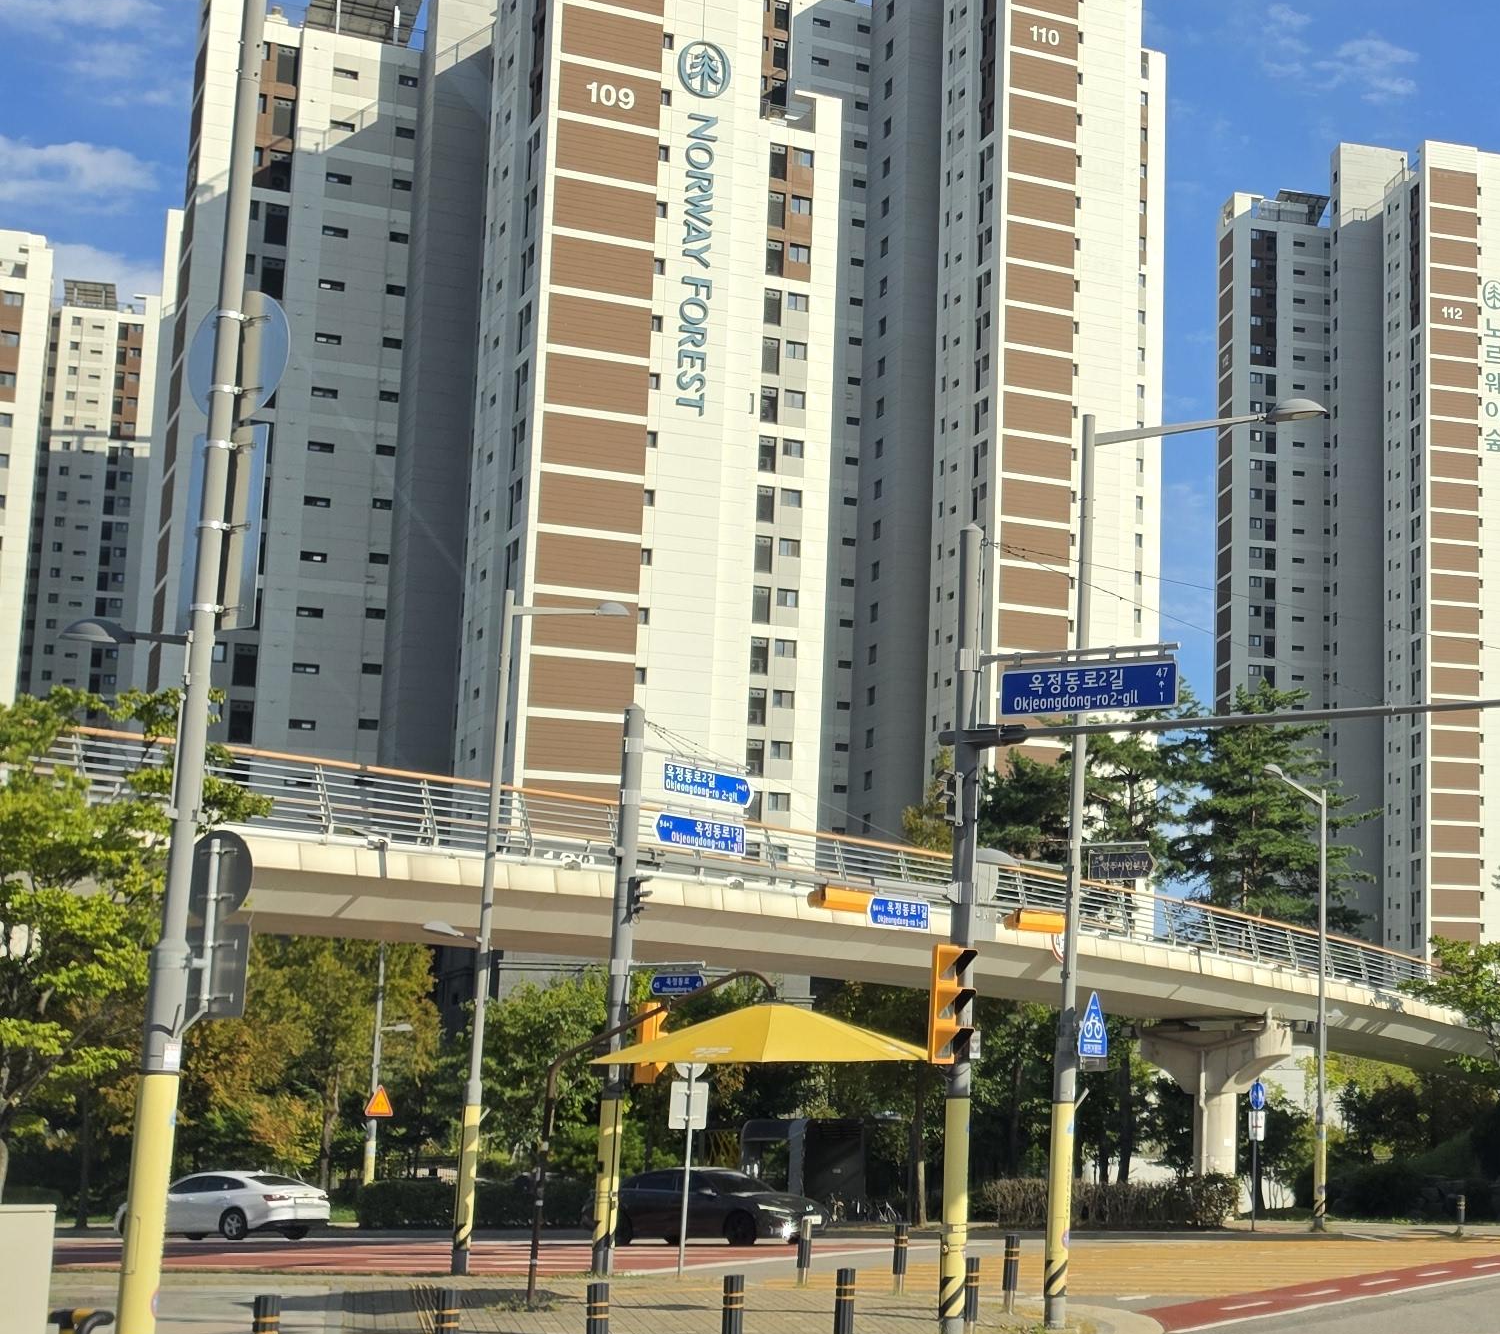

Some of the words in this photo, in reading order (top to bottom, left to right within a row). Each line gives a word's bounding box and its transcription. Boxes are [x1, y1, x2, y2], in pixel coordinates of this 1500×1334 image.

[1030, 25, 1060, 46] 110
[586, 81, 635, 110] 109
[682, 112, 719, 269] NORWAY
[1442, 306, 1463, 320] 112
[675, 275, 713, 417] FOREST
[1028, 669, 1124, 695] 옥정동로2길
[1155, 667, 1169, 678] 47
[1160, 692, 1164, 702] 1
[666, 765, 716, 788] 옥정동로2길
[665, 780, 720, 799] Okjeongdong-ro
[721, 790, 738, 803] 2-gil
[671, 831, 726, 850] Okjeongdong-ro
[728, 839, 743, 854] 1-gil
[694, 821, 743, 843] 옥정동로1길
[887, 901, 928, 919] 옥정동로1길
